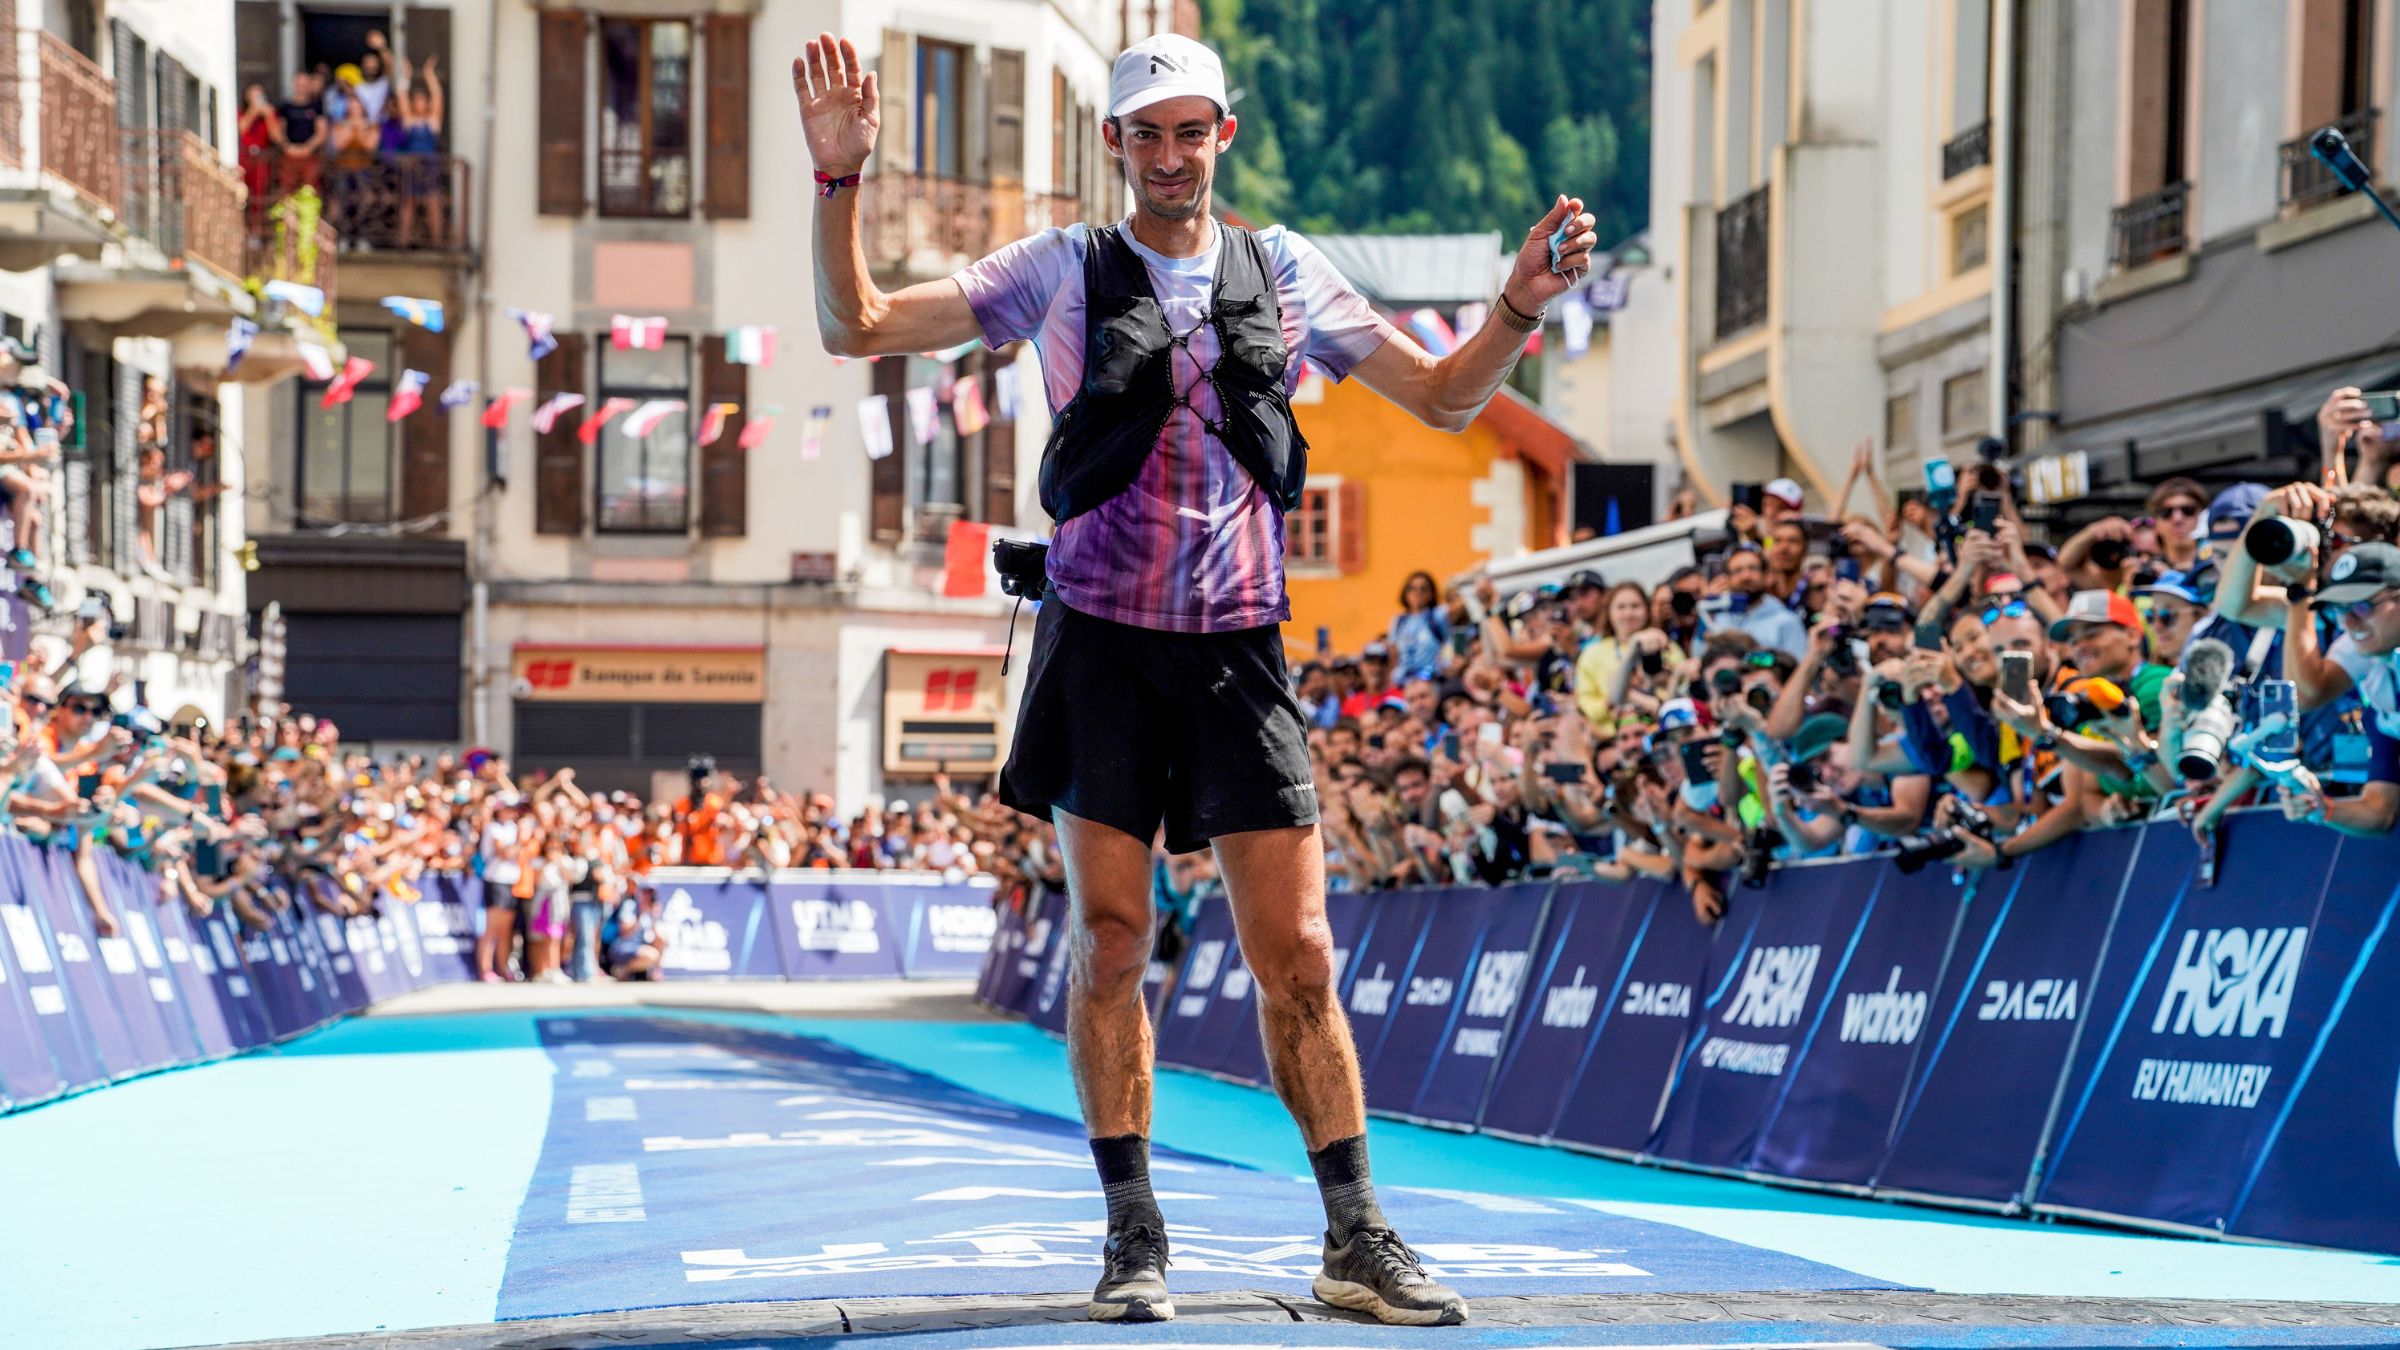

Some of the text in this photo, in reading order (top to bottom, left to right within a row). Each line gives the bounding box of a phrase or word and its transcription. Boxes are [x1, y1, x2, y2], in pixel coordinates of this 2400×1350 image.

[1622, 981, 1692, 1018] DACIA
[1721, 945, 1822, 1027] HOKA
[1840, 965, 1927, 1045] wahoo
[1978, 979, 2078, 1021] DACIA
[2151, 927, 2309, 1038] HOKA
[2132, 1058, 2272, 1108] FLY HUMAN FLY
